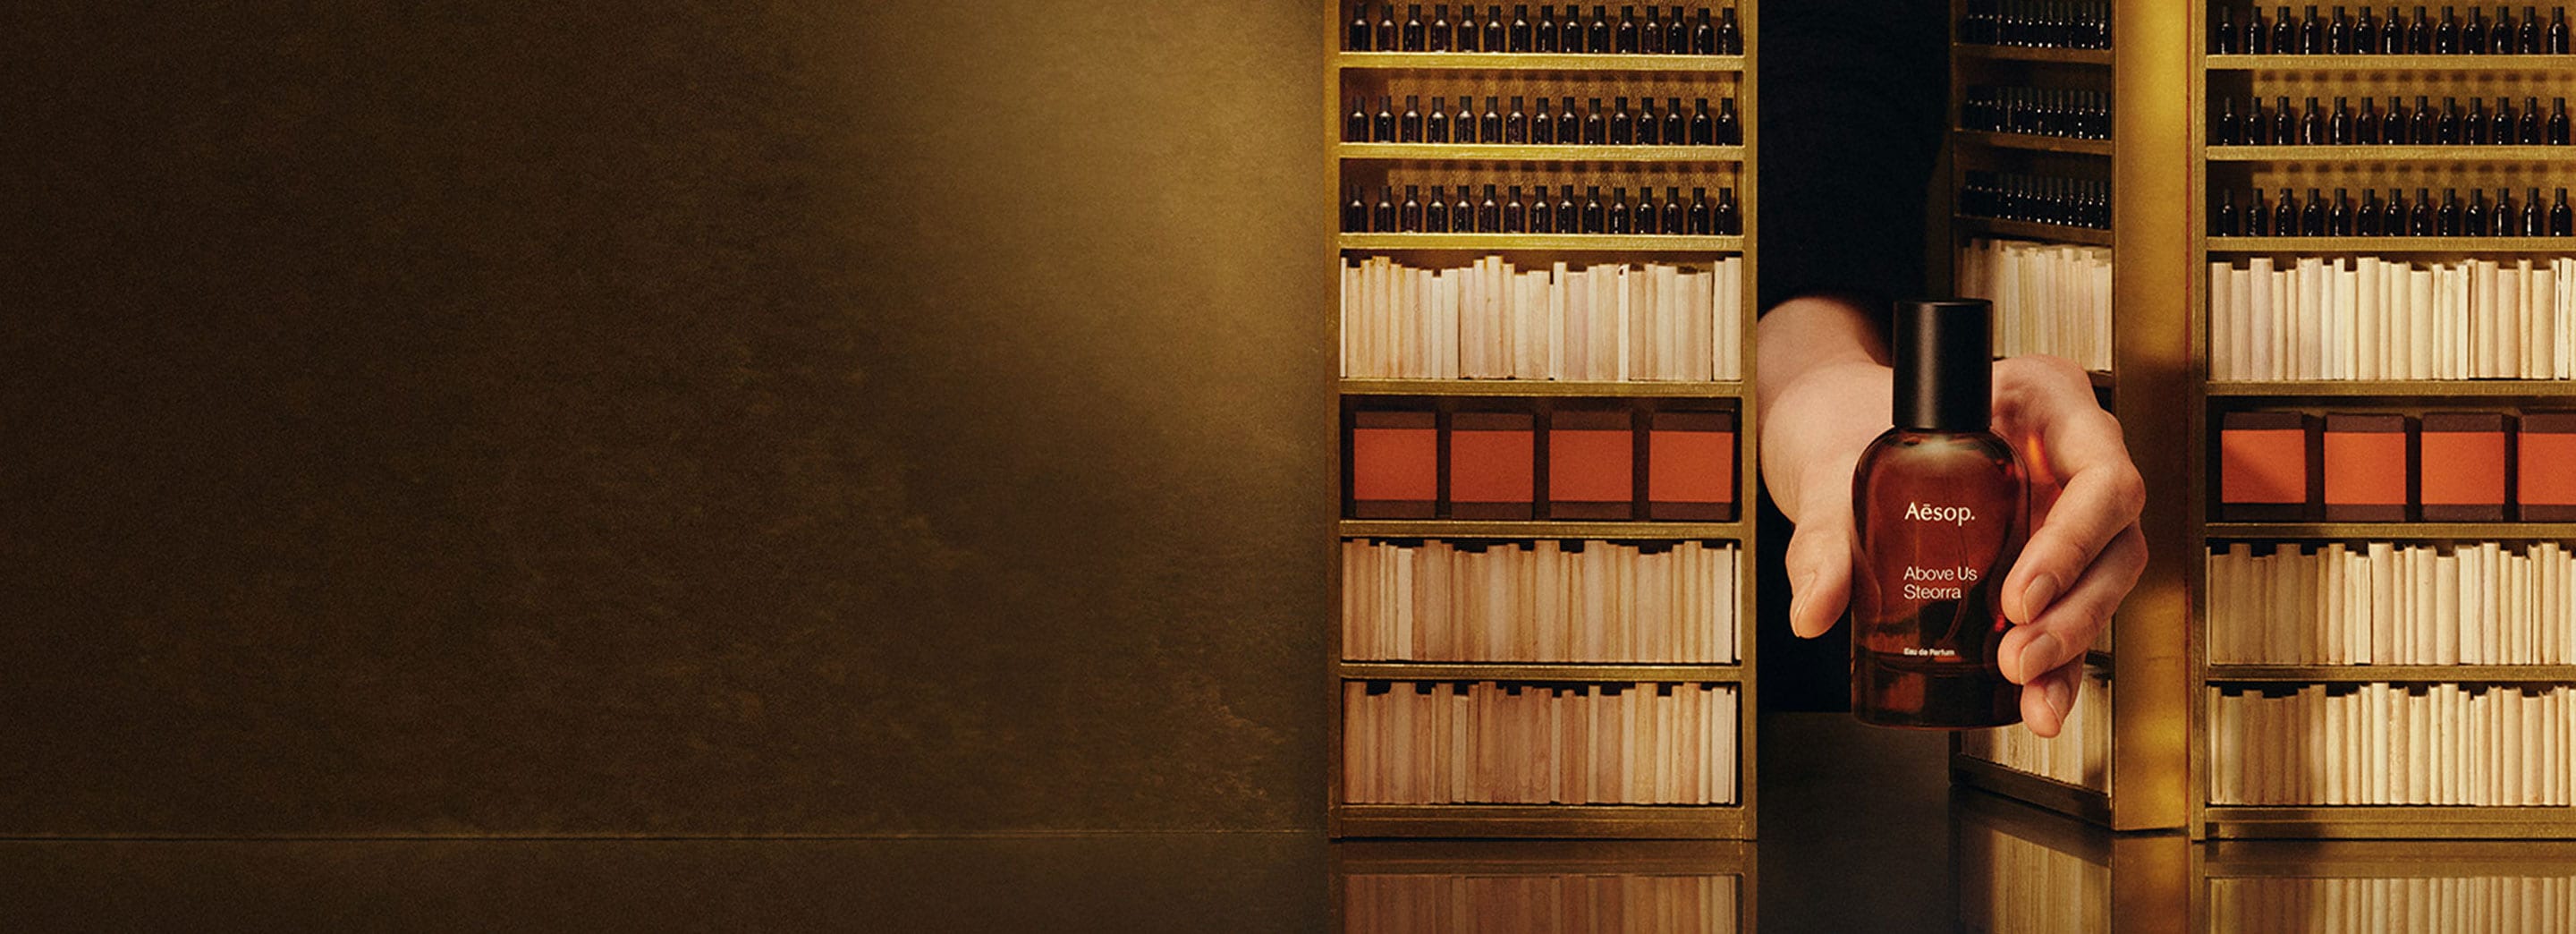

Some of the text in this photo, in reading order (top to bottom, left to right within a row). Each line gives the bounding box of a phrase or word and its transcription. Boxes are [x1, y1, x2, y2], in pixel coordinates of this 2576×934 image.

[1903, 566, 1978, 581] Above Us
[1903, 584, 1962, 599] Steorra
[1903, 648, 1955, 656] Eau de Parfum
